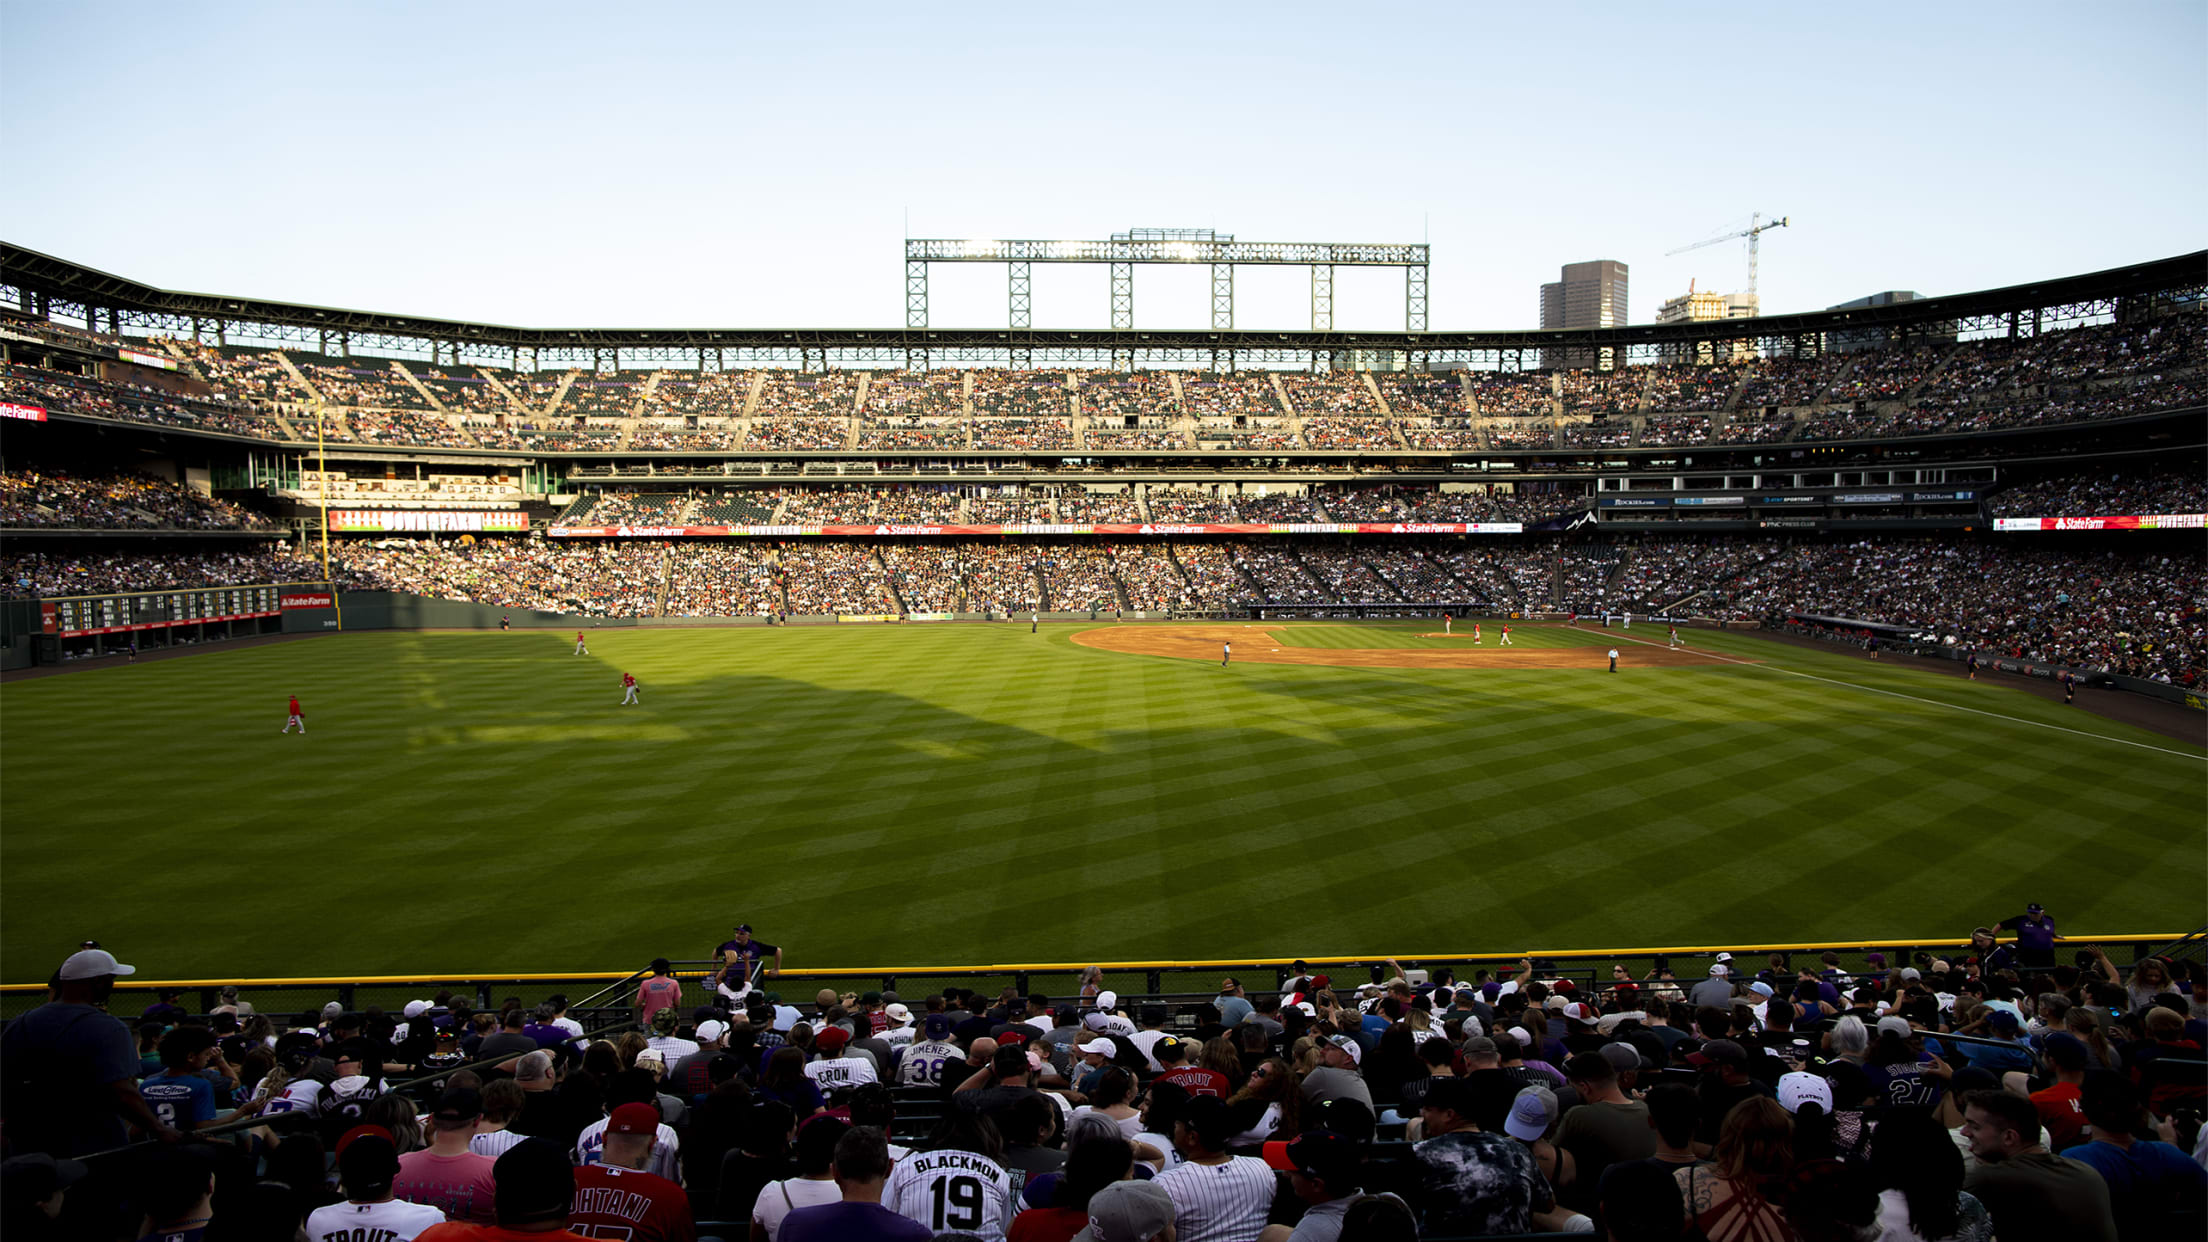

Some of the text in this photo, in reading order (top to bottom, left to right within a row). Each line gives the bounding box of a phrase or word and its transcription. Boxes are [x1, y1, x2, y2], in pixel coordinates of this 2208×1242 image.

[910, 1044, 951, 1057] JIMENEZ
[818, 1068, 849, 1083] CRON
[911, 1058, 945, 1082] 38
[914, 1155, 1000, 1183] BLACKMON
[930, 1174, 983, 1230] 19
